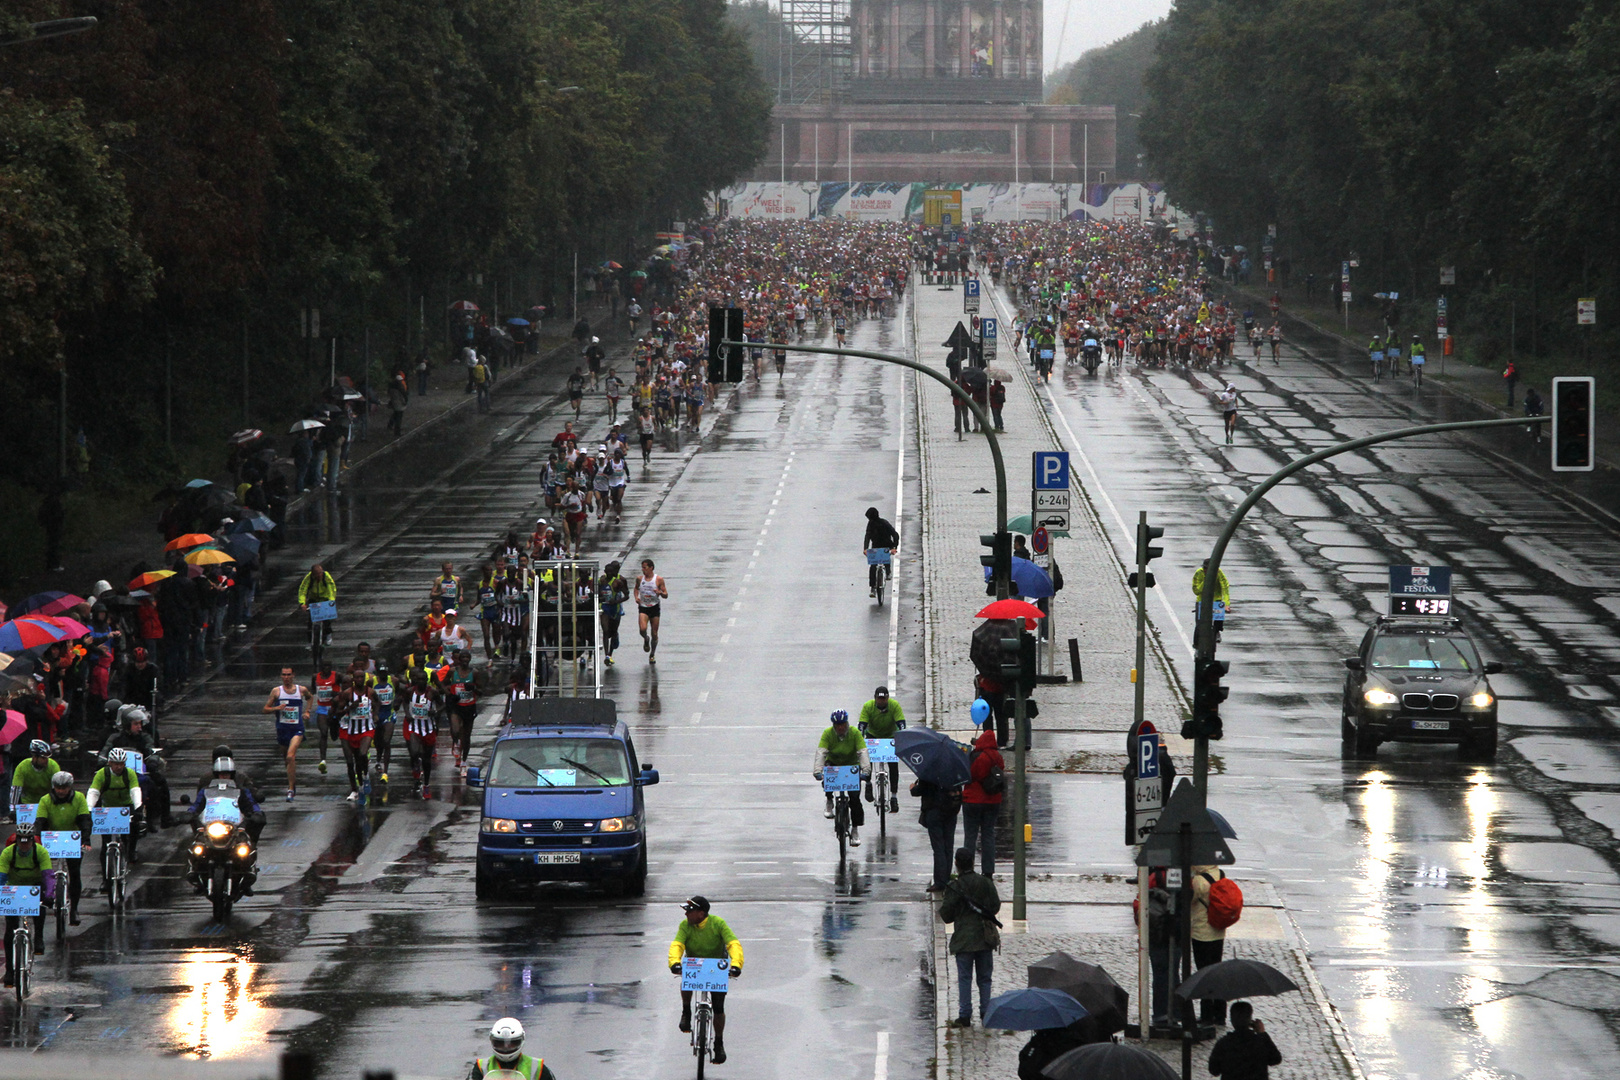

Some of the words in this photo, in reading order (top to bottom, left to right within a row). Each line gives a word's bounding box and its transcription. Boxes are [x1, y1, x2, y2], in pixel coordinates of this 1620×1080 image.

[969, 282, 976, 295] P
[986, 320, 995, 337] P
[1043, 456, 1062, 485] P
[1038, 495, 1068, 506] 6-24h
[1404, 585, 1437, 593] FESTINA
[1141, 740, 1153, 774] P
[1136, 785, 1161, 803] 6-24h
[538, 855, 549, 863] KH
[19, 906, 38, 914] Fahrt
[685, 971, 697, 979] K4
[682, 981, 704, 990] Freie
[705, 982, 727, 991] Fahrt
